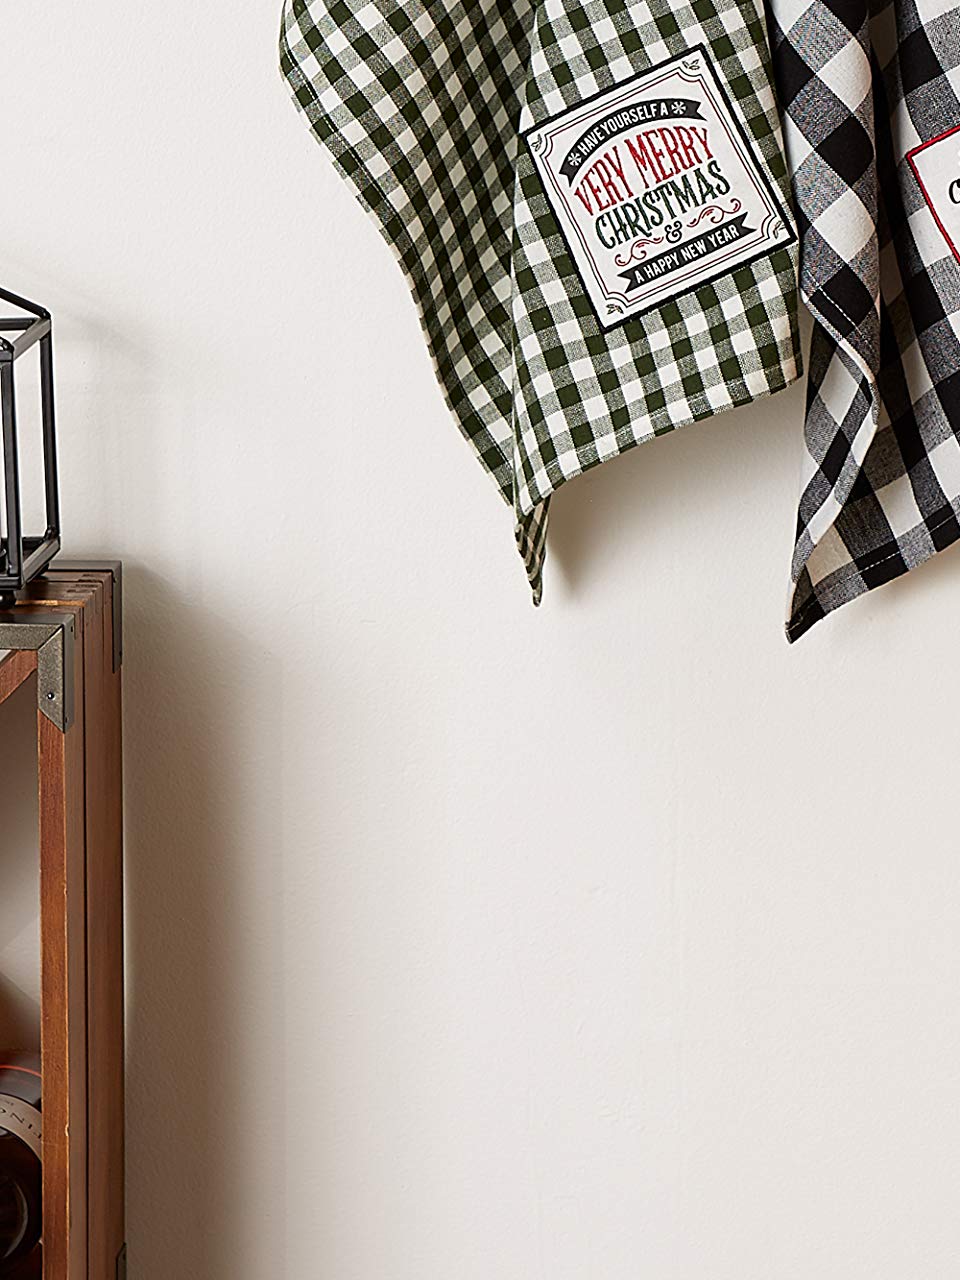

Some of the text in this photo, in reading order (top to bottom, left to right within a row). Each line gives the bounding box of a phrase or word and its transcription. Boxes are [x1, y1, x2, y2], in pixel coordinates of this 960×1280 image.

[577, 102, 669, 156] HAVE YOURSELF A
[574, 126, 713, 216] VERY MERRY
[595, 160, 730, 249] CHRISTMAS
[665, 220, 682, 243] &
[634, 224, 740, 284] A HAPPY NEW YEAR
